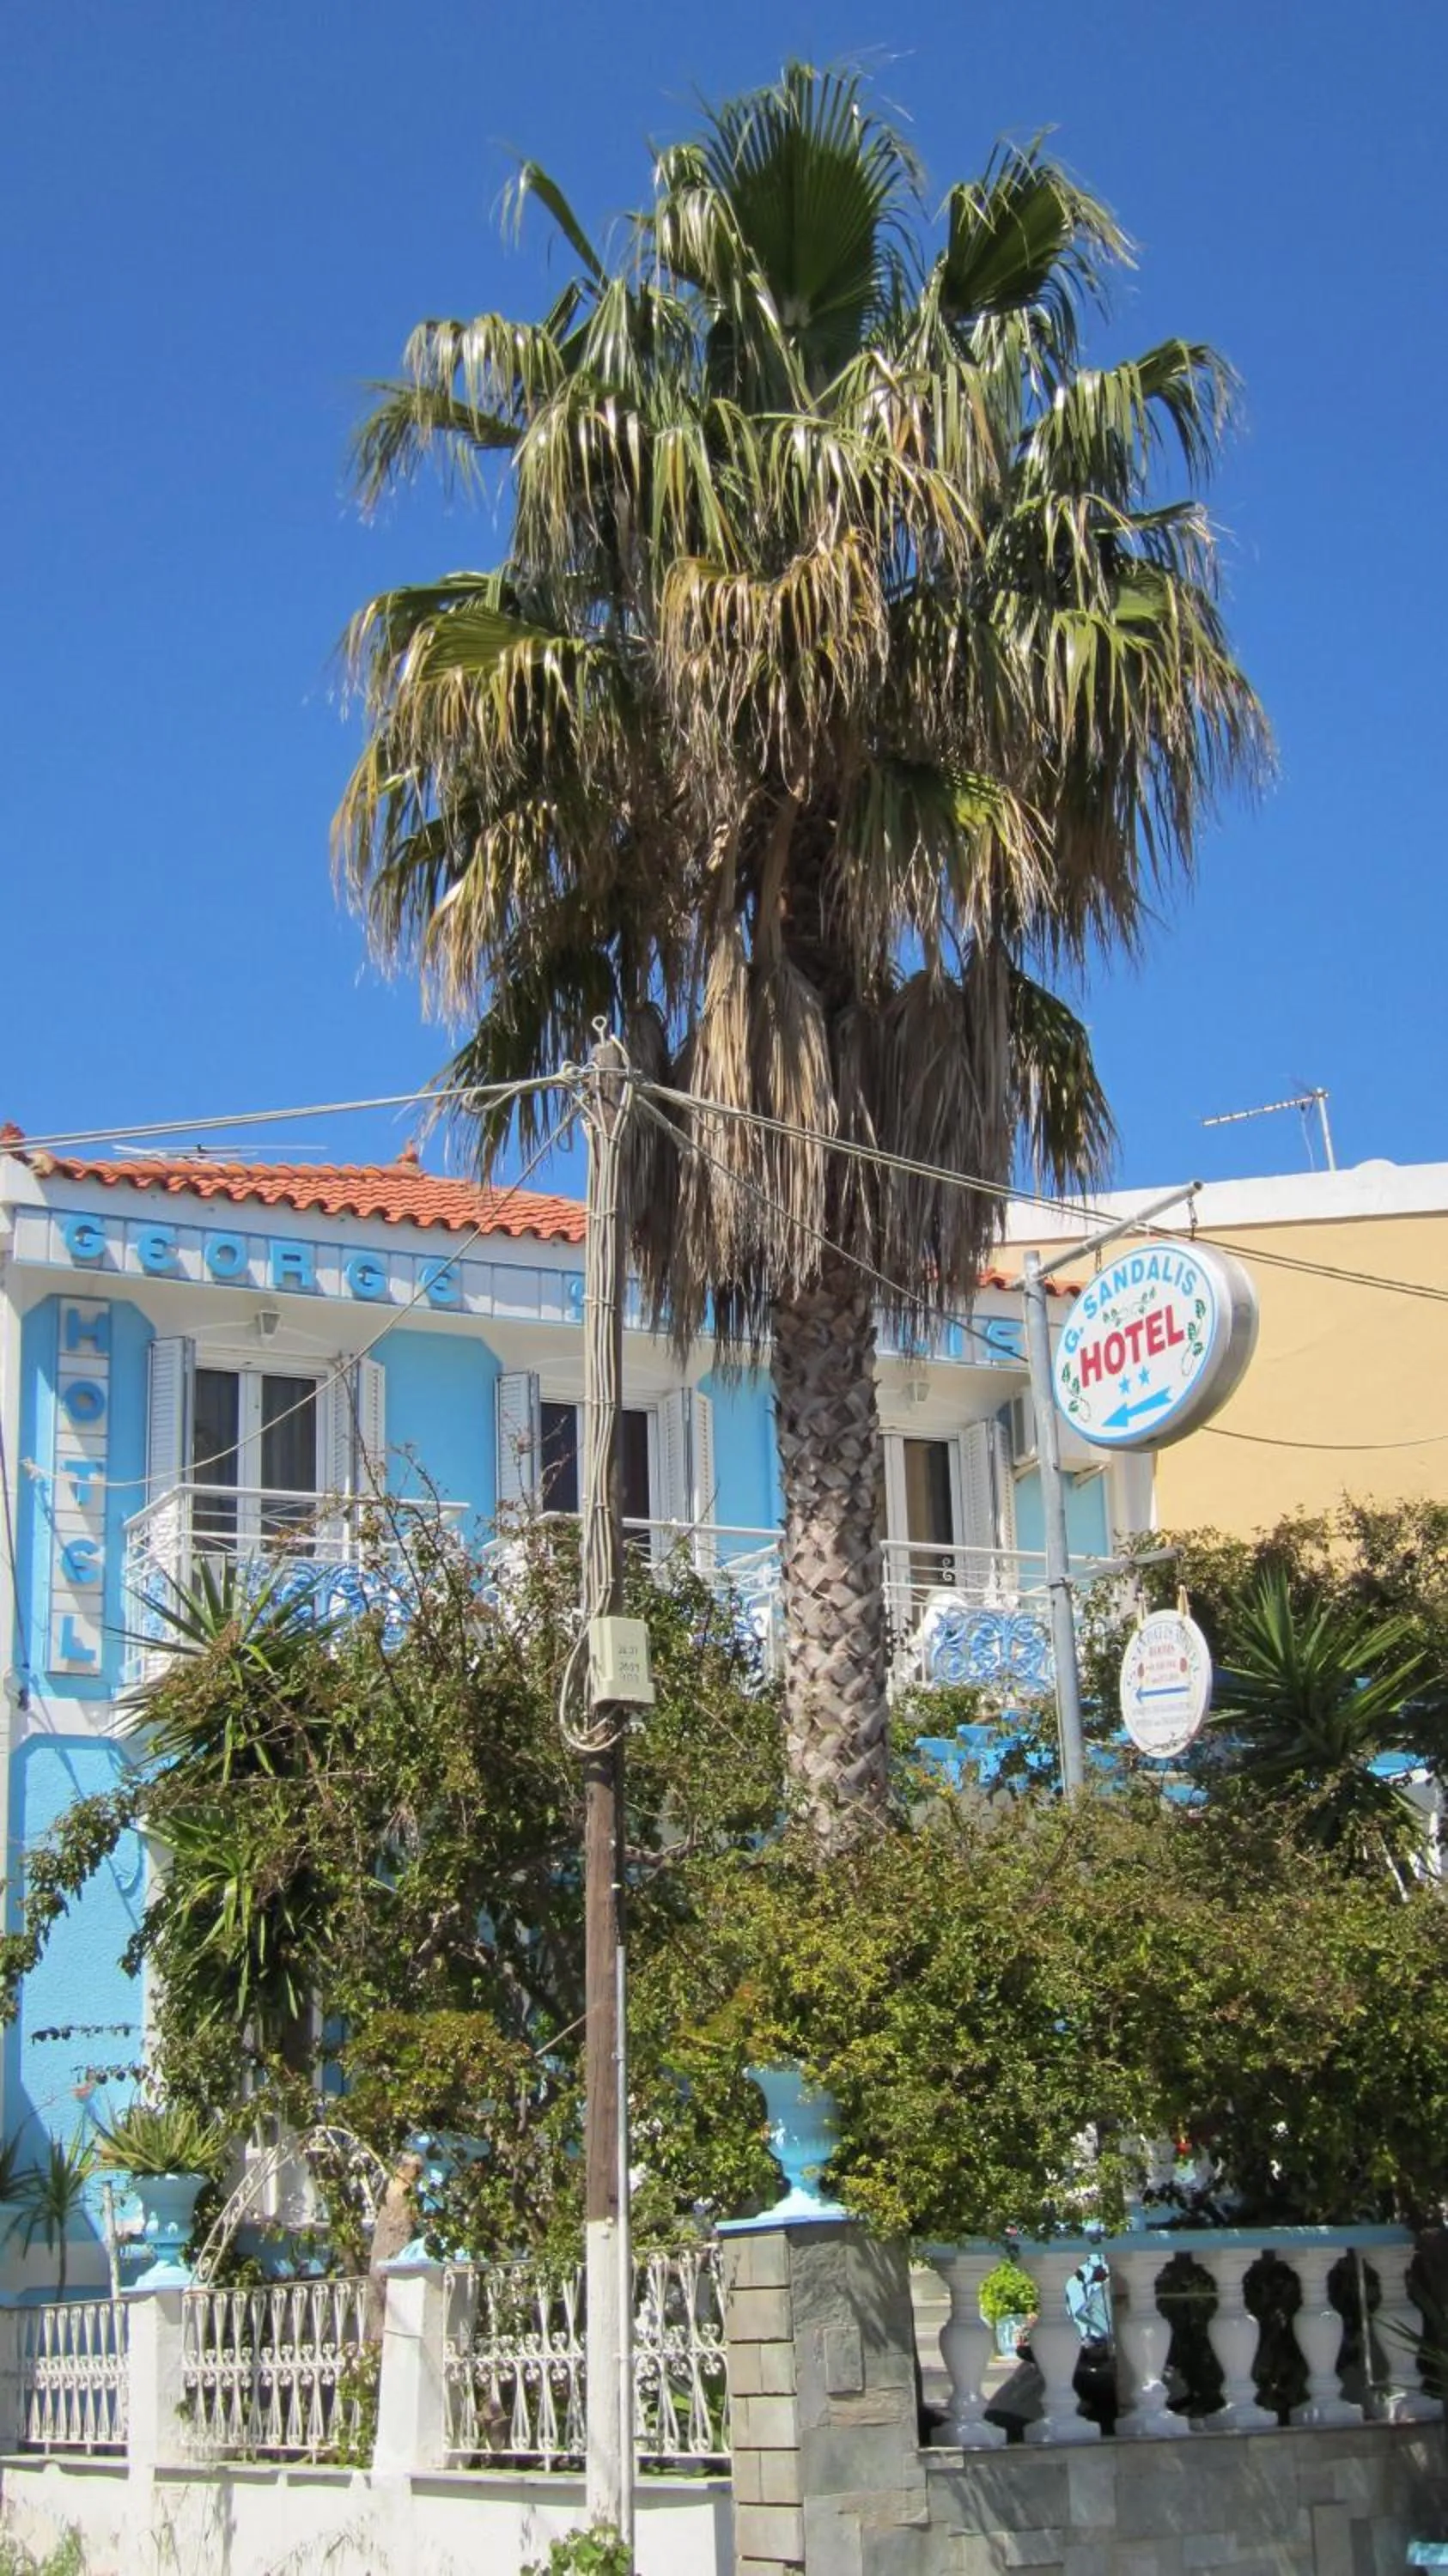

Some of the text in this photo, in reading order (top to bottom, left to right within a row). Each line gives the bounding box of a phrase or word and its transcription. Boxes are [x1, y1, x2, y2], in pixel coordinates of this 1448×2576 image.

[63, 1213, 462, 1303] GEORGE
[1083, 1255, 1197, 1320] SANDALIS
[1080, 1304, 1185, 1388] HOTEL
[58, 1307, 110, 1662] HOTEL
